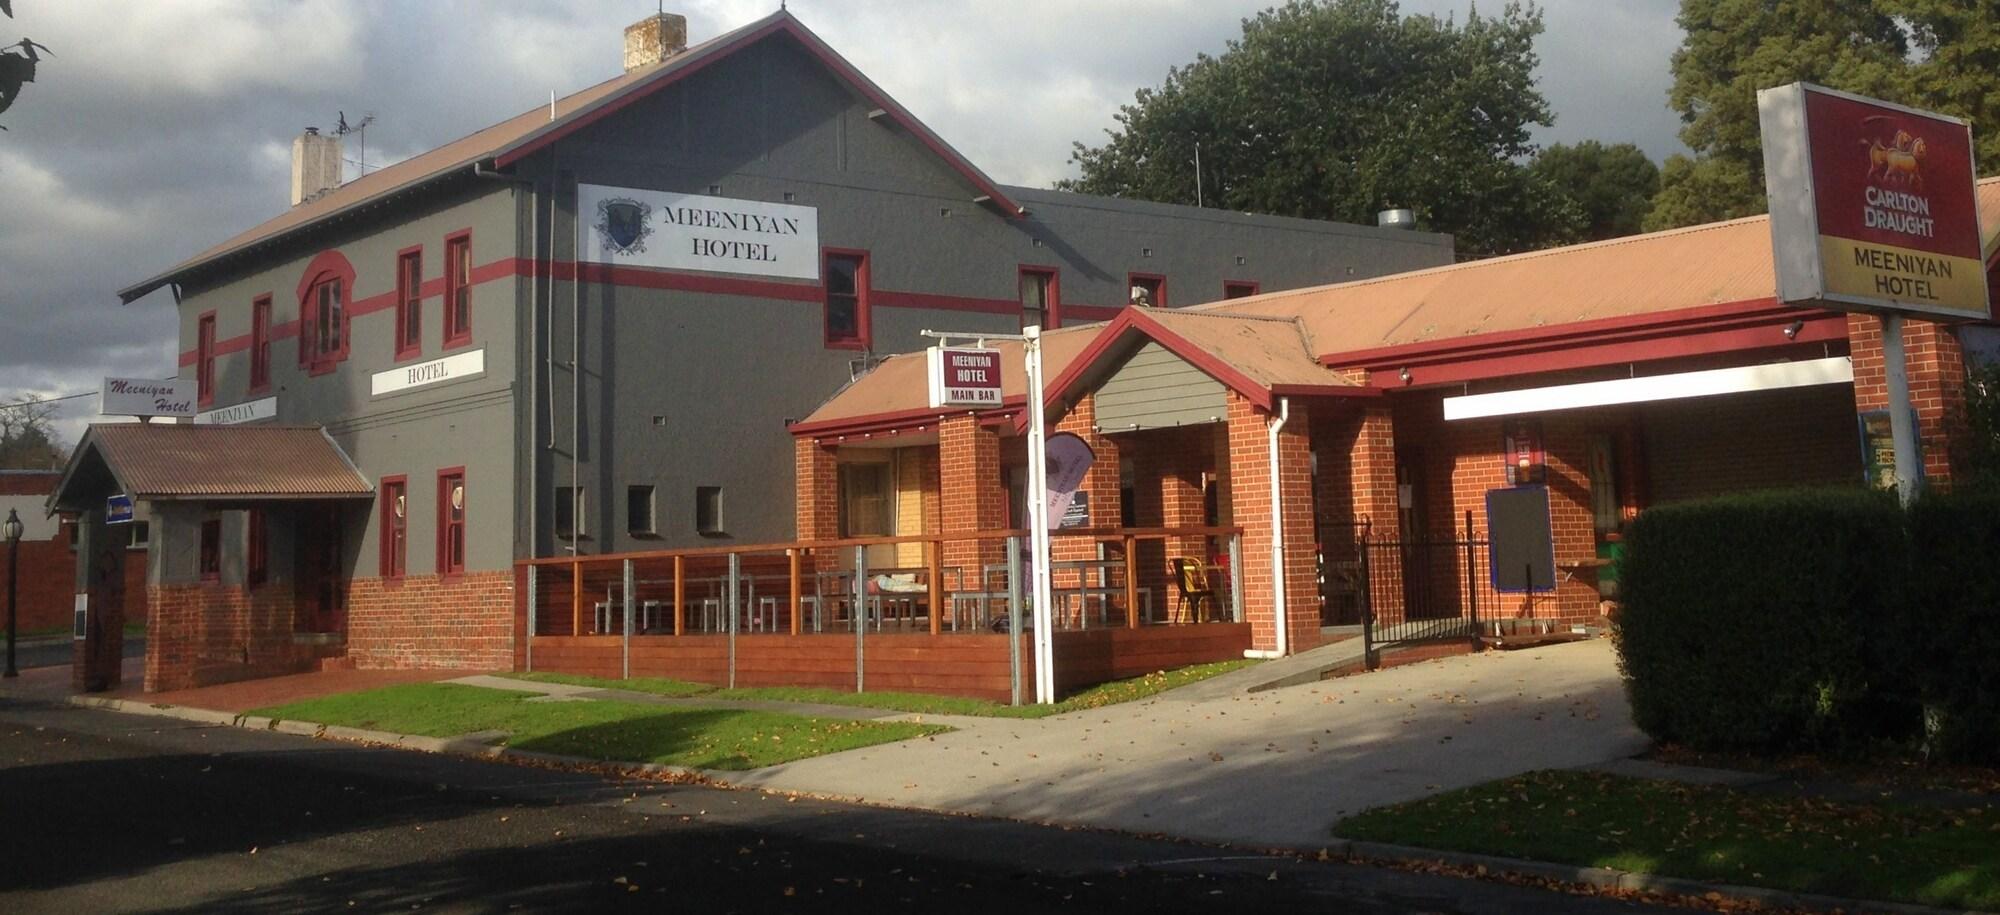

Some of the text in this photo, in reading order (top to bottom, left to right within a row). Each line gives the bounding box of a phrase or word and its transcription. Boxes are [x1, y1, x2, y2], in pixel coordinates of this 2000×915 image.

[1865, 187, 1929, 215] CARLTON
[663, 206, 799, 235] MEENIYAN
[1864, 207, 1934, 237] DRAUGHT
[692, 238, 777, 262] HOTEL
[1854, 248, 1952, 279] MEENIYAN
[1875, 274, 1939, 300] HOTEL
[408, 361, 448, 384] HOTEL
[952, 355, 992, 367] MEENIYAN
[957, 370, 988, 382] HOTEL
[111, 380, 174, 396] Meeniyan
[951, 390, 995, 401] MAIN BAR
[154, 398, 190, 412] Hotel
